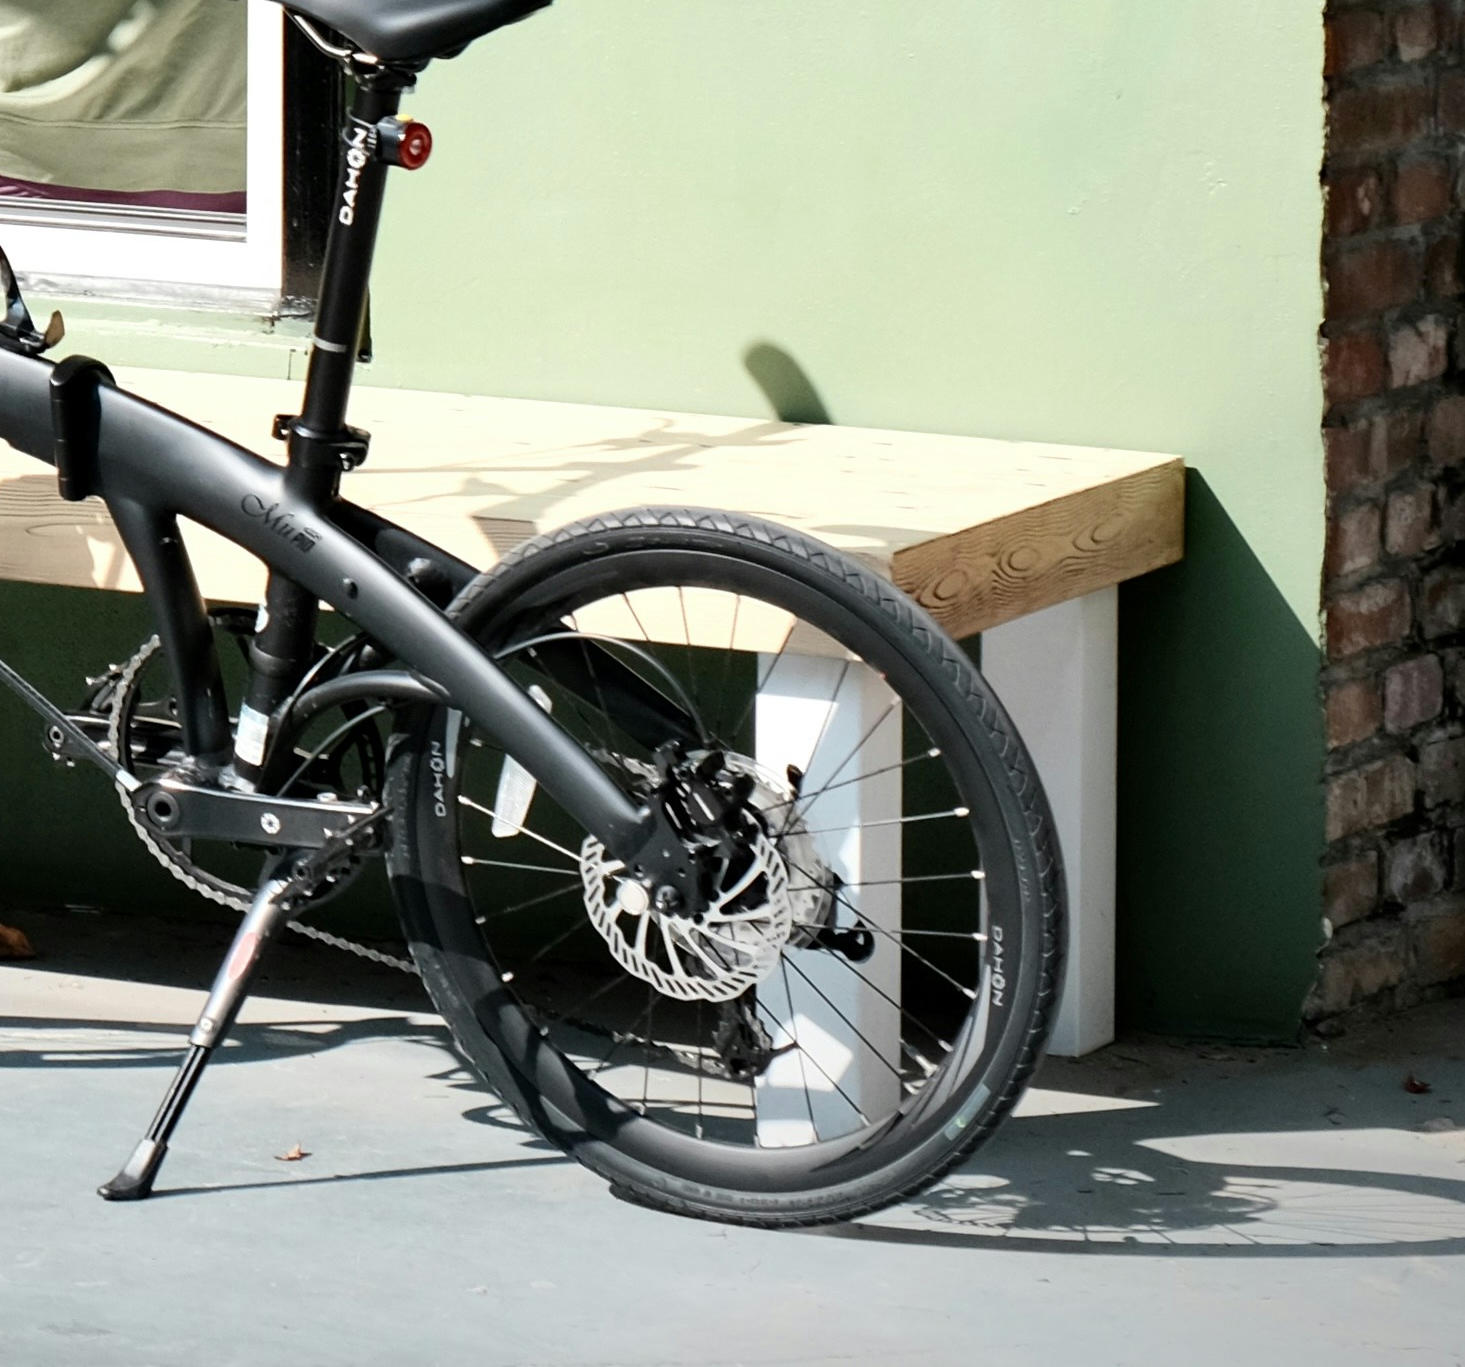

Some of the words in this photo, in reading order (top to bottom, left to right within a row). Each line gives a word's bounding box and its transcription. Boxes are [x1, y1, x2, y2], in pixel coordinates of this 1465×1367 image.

[338, 126, 369, 226] DAHON
[433, 740, 447, 817] DAHON
[991, 926, 1005, 1008] DAHON
